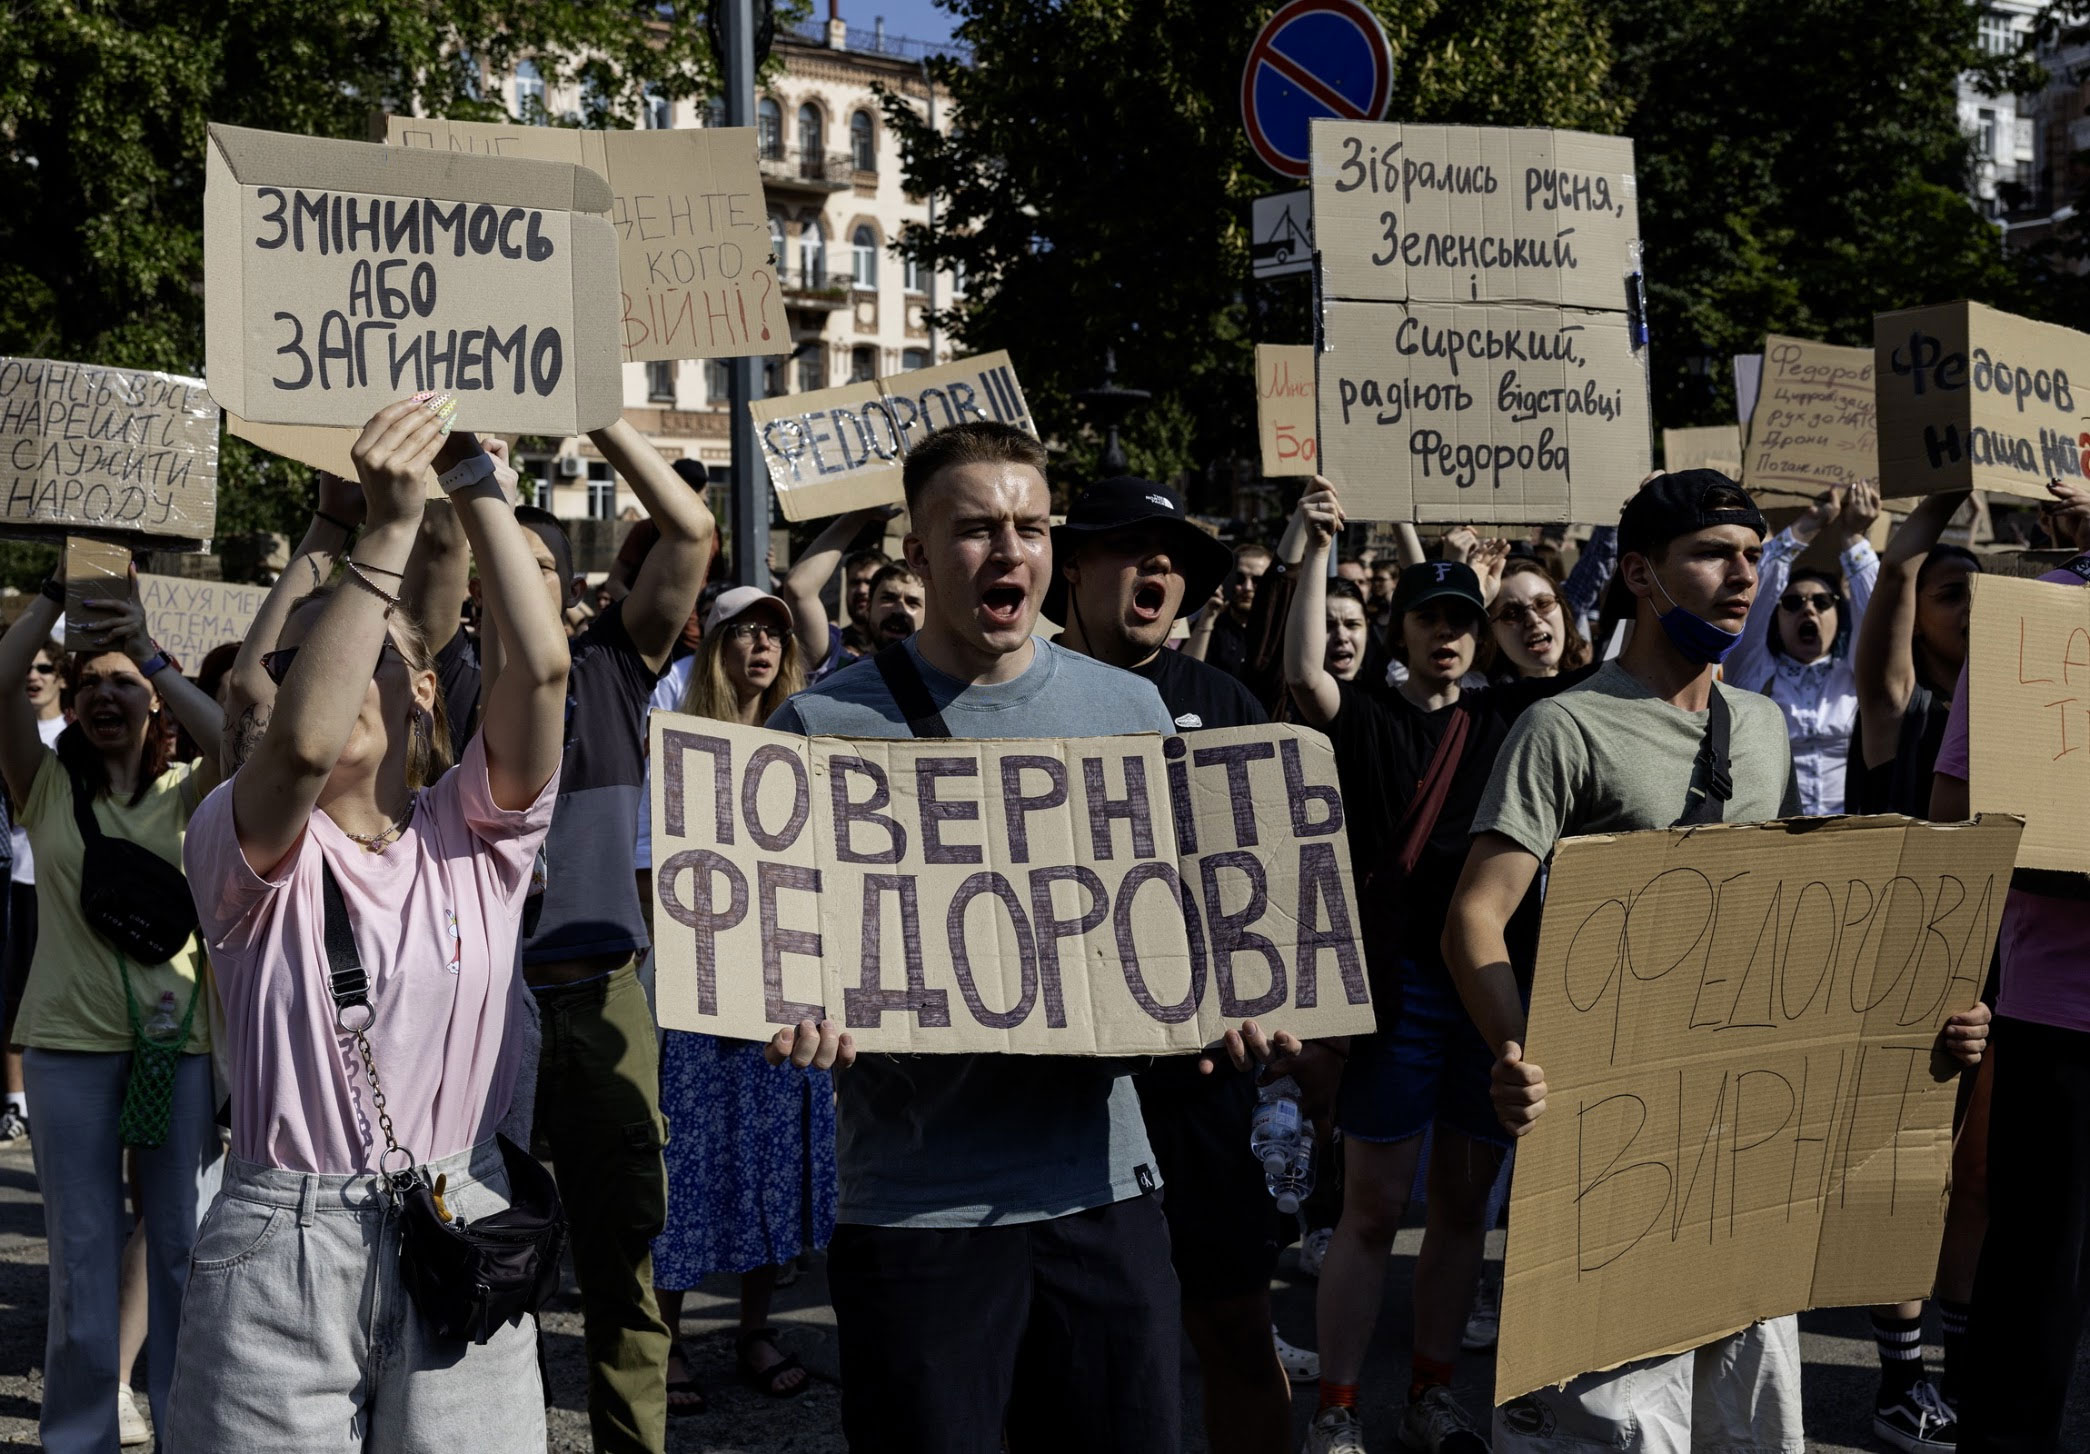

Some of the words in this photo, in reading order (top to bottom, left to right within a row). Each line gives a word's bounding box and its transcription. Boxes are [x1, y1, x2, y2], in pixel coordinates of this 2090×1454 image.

[1335, 137, 1498, 203] Зібрались
[1525, 166, 1625, 219] русня,
[256, 186, 555, 262] ЗМІНИМОСЬ
[1372, 211, 1577, 268] Зеленський
[350, 258, 437, 320] АБО
[646, 241, 743, 285] КОГО
[272, 310, 563, 397] ЗАГИНЕМО
[1394, 316, 1587, 376] Сирський,
[1339, 377, 1473, 425] радіють
[1498, 369, 1622, 423] відставці
[1409, 427, 1571, 490] Федорова
[6, 477, 173, 524] НАРОДУ
[657, 841, 1370, 1028] ФЕДОРОВА
